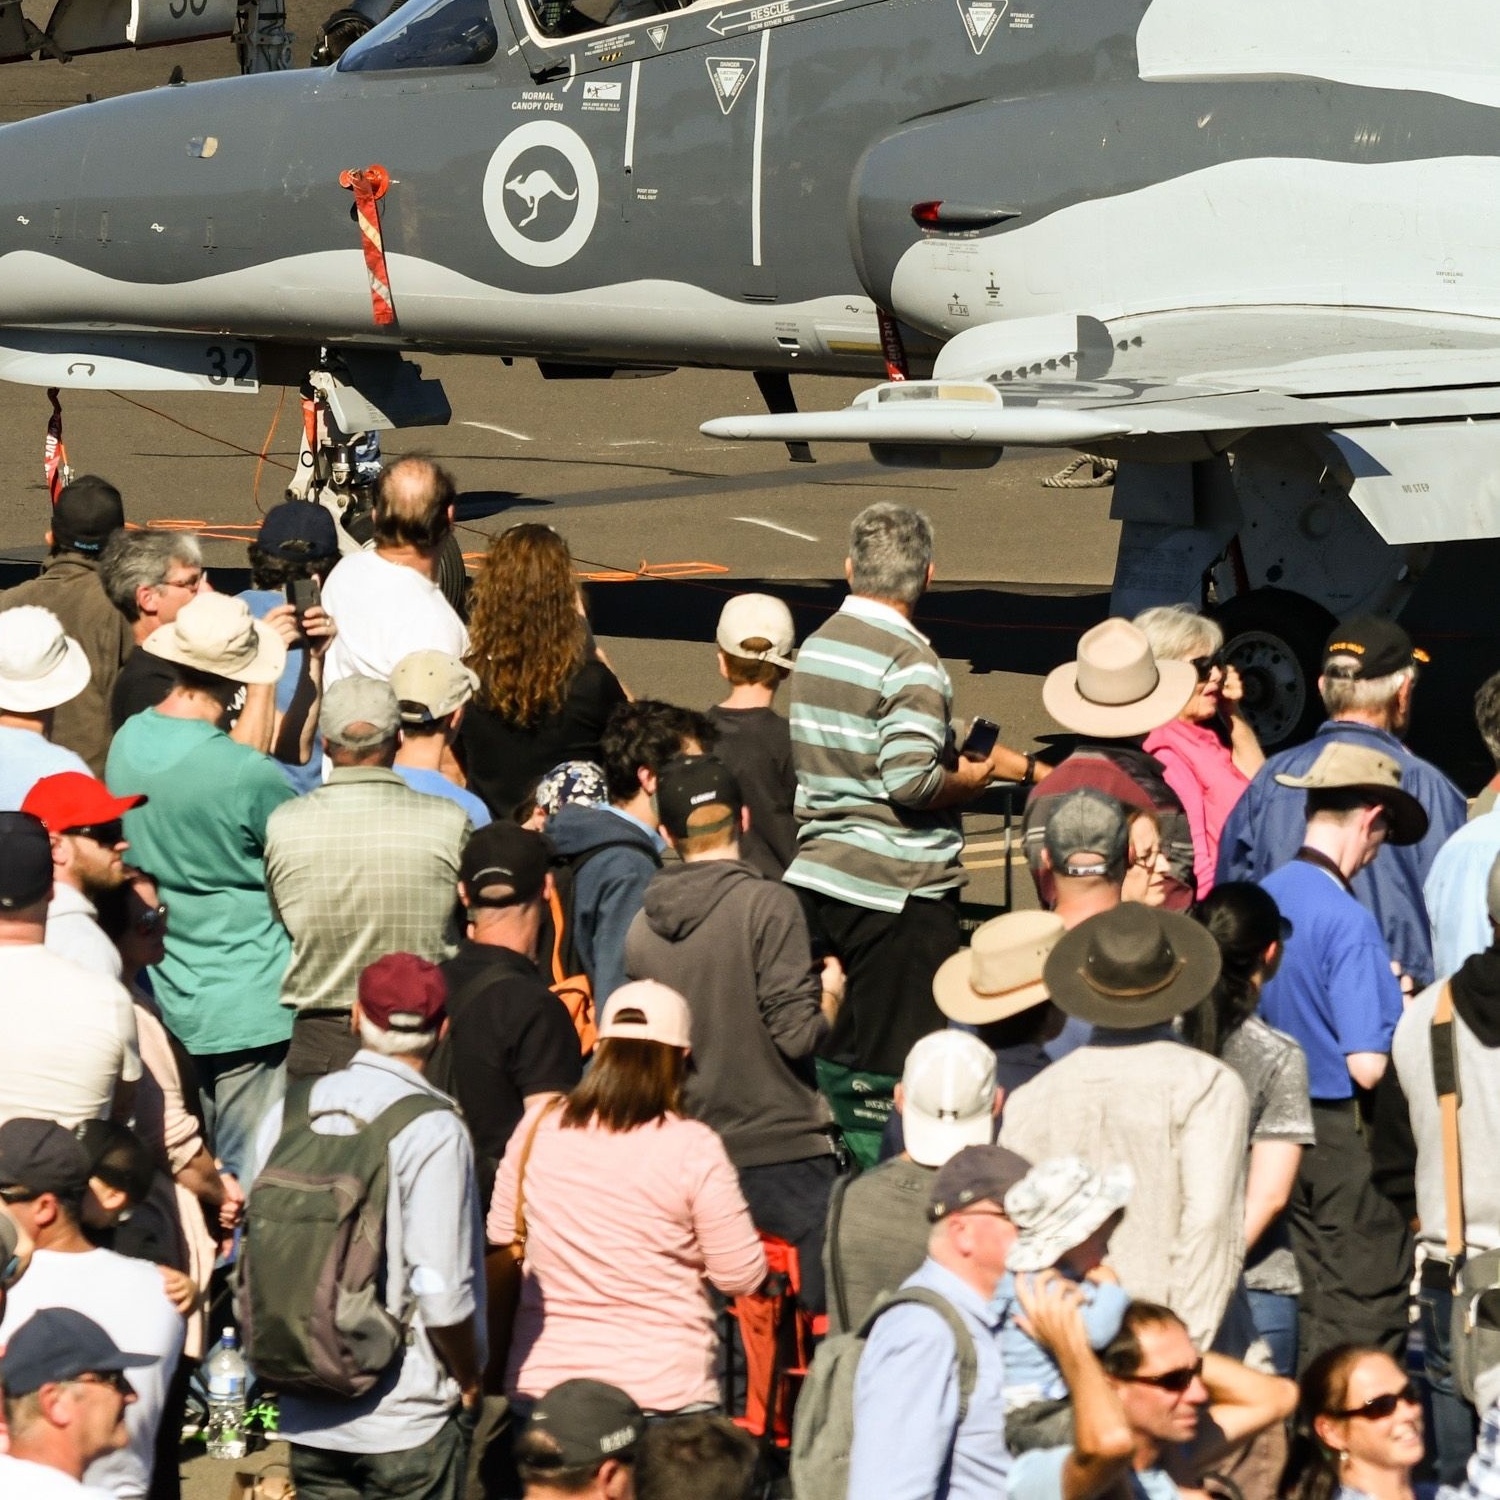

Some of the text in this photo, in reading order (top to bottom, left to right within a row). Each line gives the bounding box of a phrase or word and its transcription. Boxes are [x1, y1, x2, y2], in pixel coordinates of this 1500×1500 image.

[750, 1, 790, 21] RESCUE
[521, 91, 555, 101] NORMAL
[511, 101, 564, 112] CANOPY OPEN
[205, 346, 256, 388] 32
